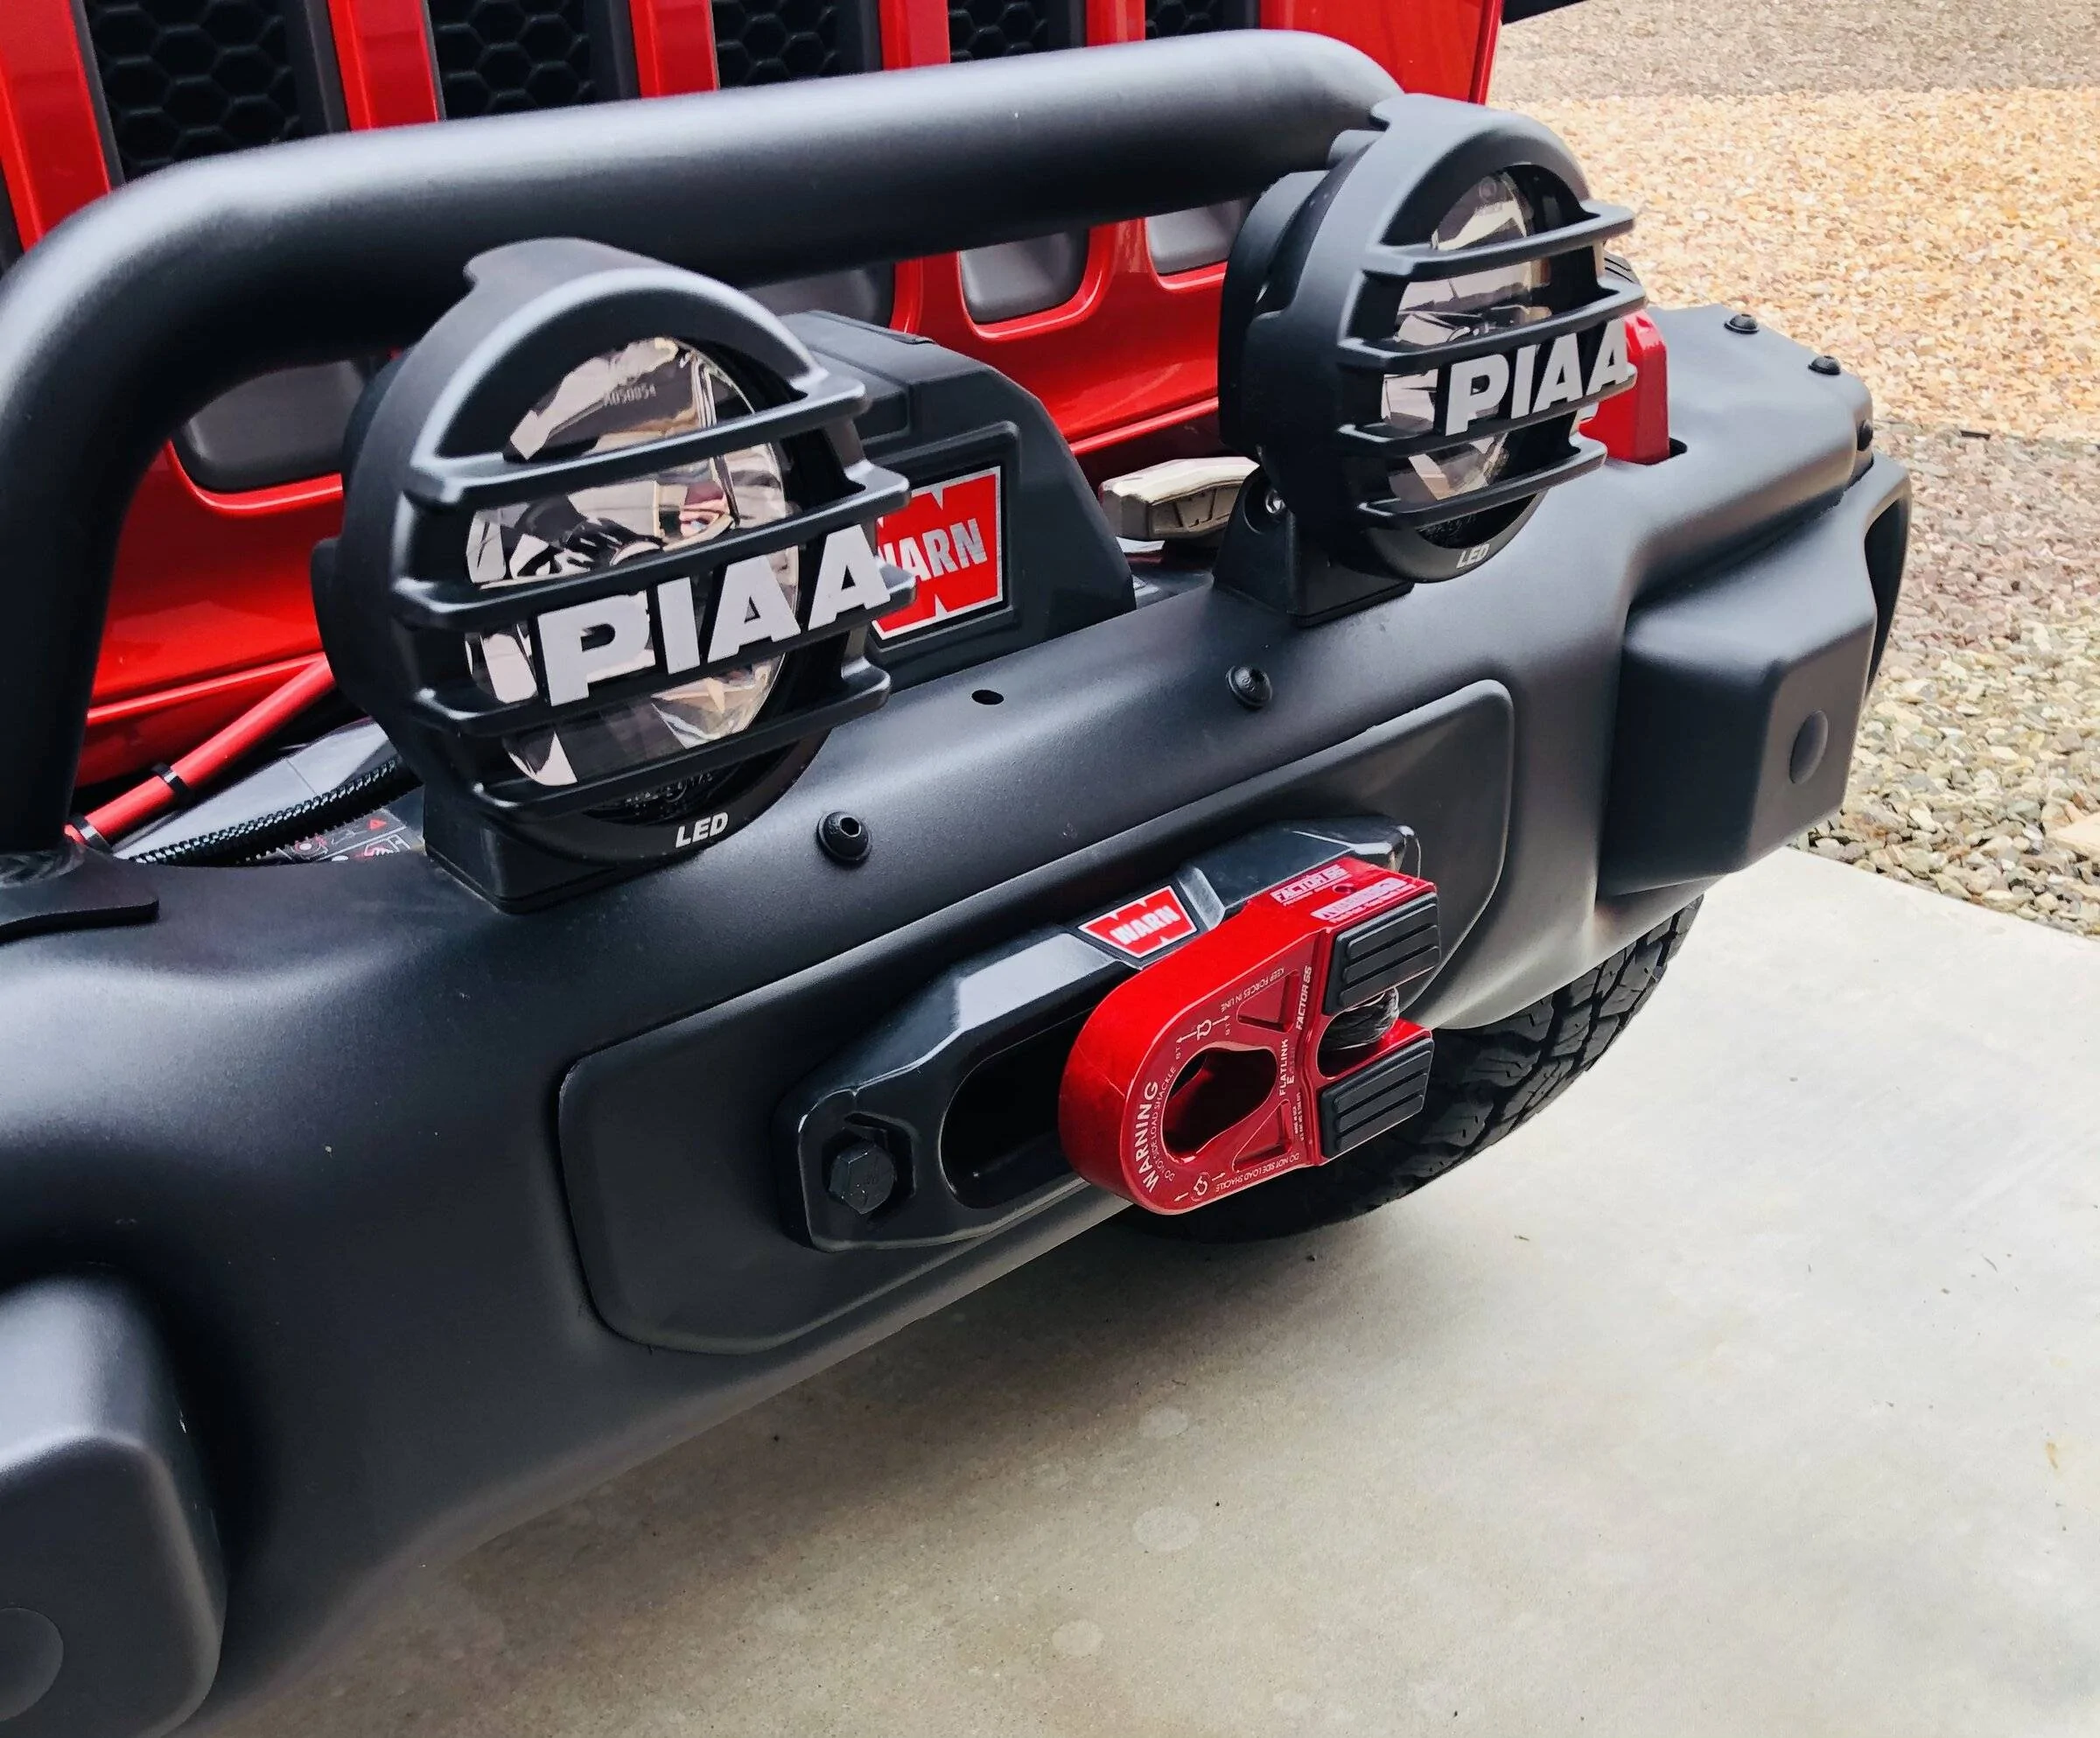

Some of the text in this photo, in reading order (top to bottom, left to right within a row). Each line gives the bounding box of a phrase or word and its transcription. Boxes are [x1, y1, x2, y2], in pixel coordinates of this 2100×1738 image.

[1445, 319, 1630, 437] PIAA
[1456, 543, 1491, 569] LED
[537, 524, 891, 707] PIAA
[675, 812, 729, 848] LED
[1110, 905, 1181, 945] WARN
[1295, 985, 1309, 1030] FACTOR
[1278, 1039, 1289, 1096] FLATLINK
[1153, 1067, 1177, 1110] SHACKLE
[1134, 1081, 1159, 1194] WARNING
[1150, 1111, 1158, 1139] LOAD
[1164, 1169, 1176, 1182] DO
[1243, 1167, 1262, 1181] LOAD
[1262, 1161, 1276, 1174] SIDE
